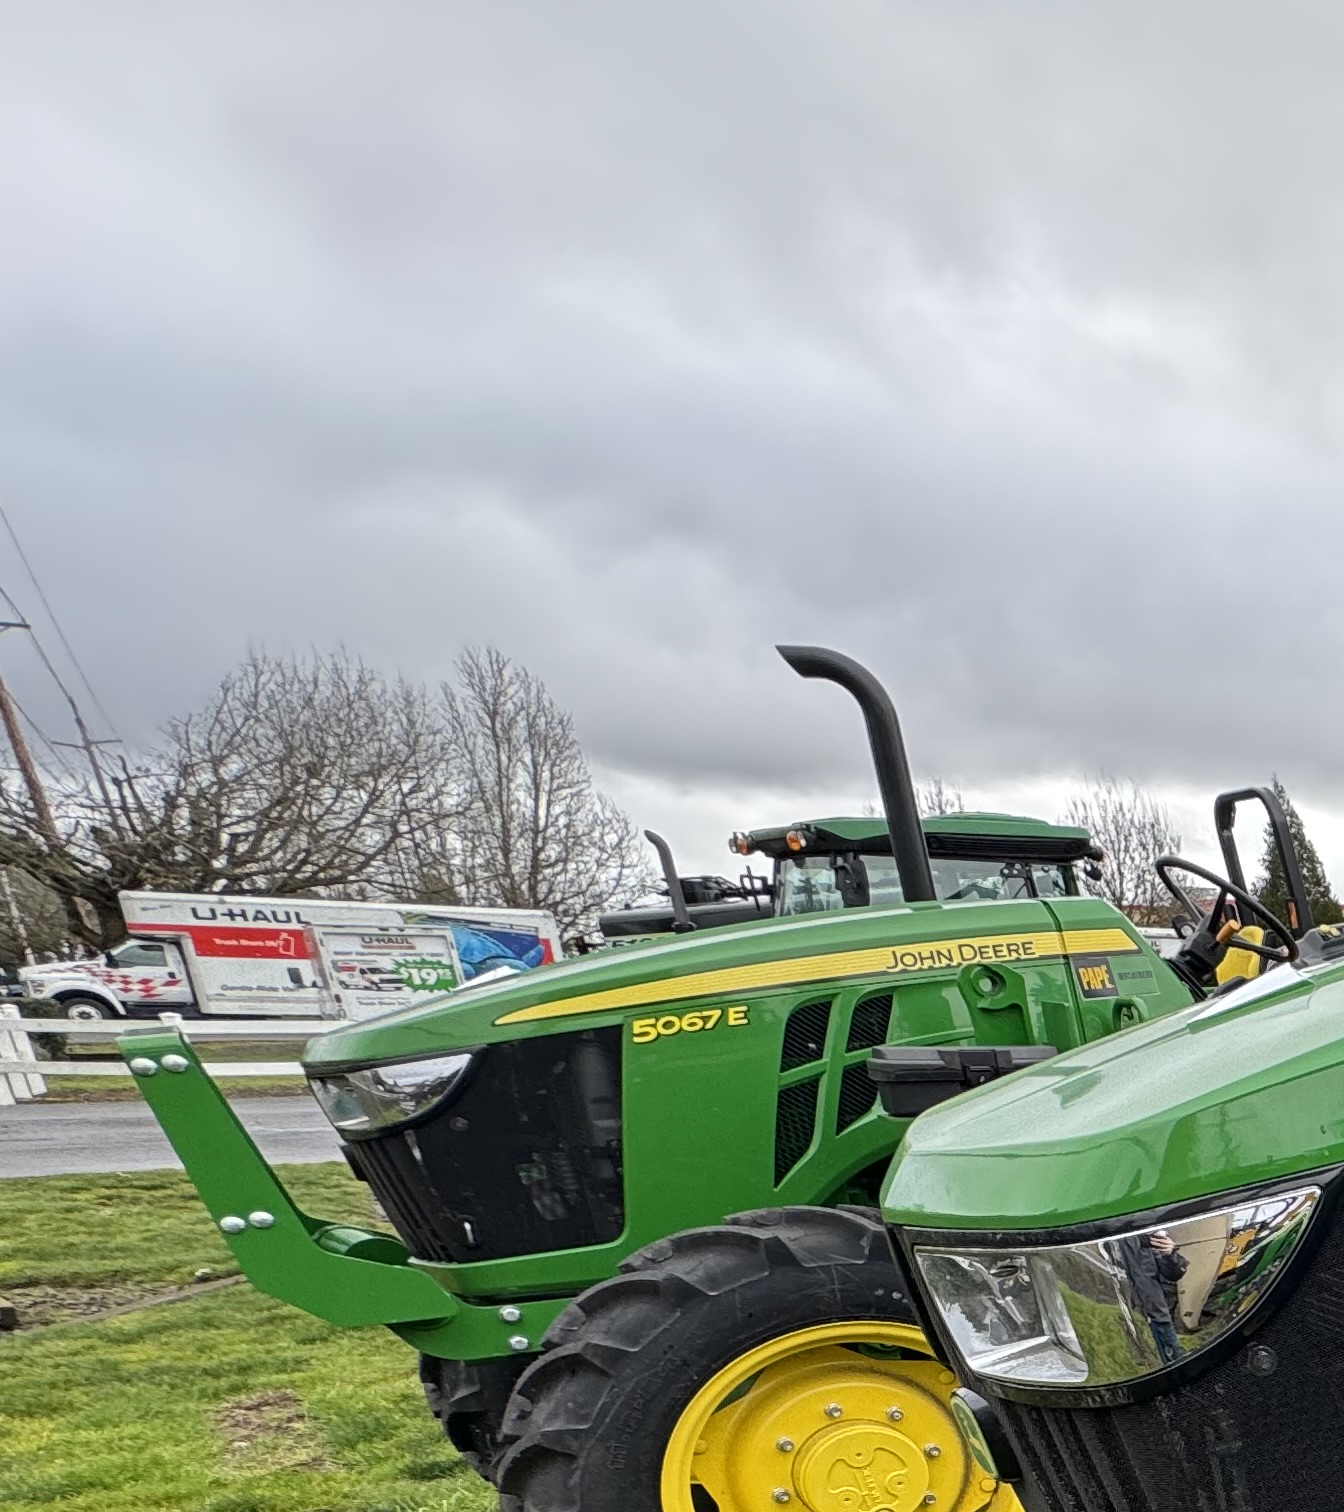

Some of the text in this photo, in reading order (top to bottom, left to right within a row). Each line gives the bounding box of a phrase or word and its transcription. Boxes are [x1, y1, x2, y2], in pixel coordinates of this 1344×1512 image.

[886, 941, 1036, 970] JOHN DEERE
[632, 1004, 750, 1044] 5067 E
